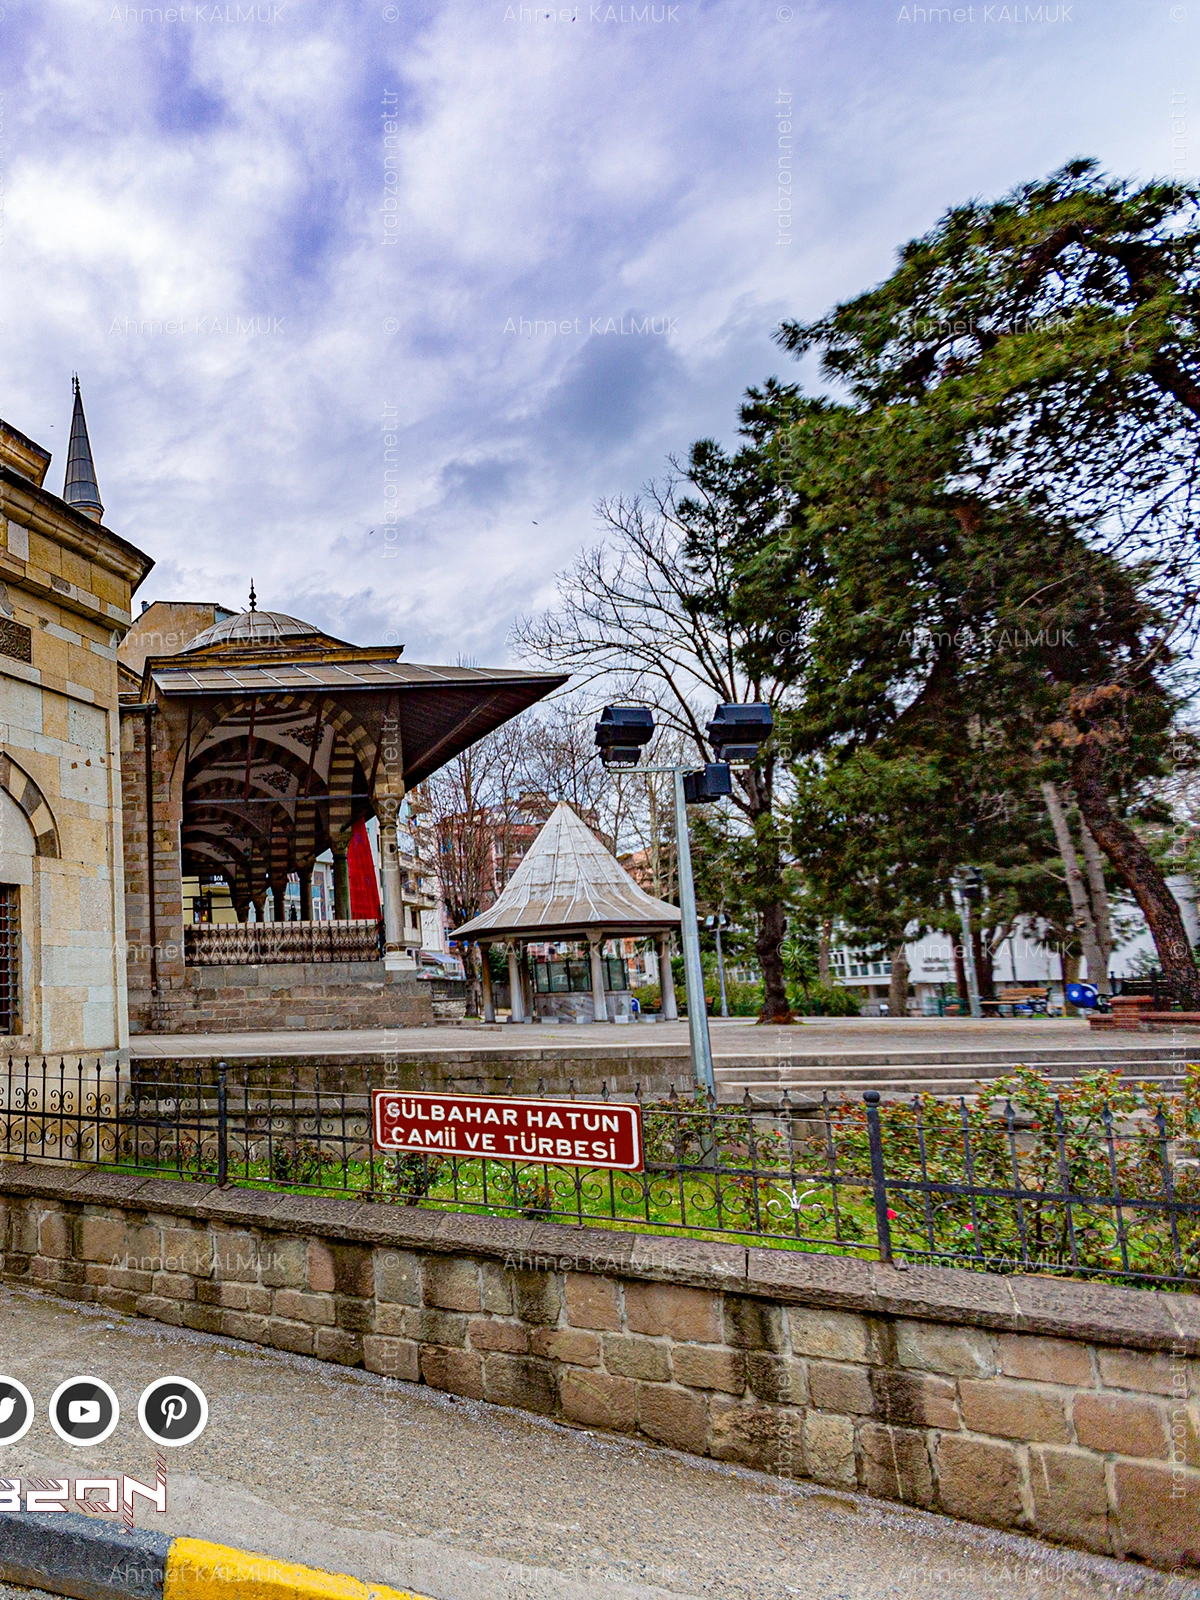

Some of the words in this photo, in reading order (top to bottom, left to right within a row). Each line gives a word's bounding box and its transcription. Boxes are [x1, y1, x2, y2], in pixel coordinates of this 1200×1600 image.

[387, 1099, 518, 1126] GÜLBAHAR
[527, 1110, 619, 1132] HATUN
[464, 1132, 496, 1150] VE
[504, 1132, 616, 1160] TÜRBESİ
